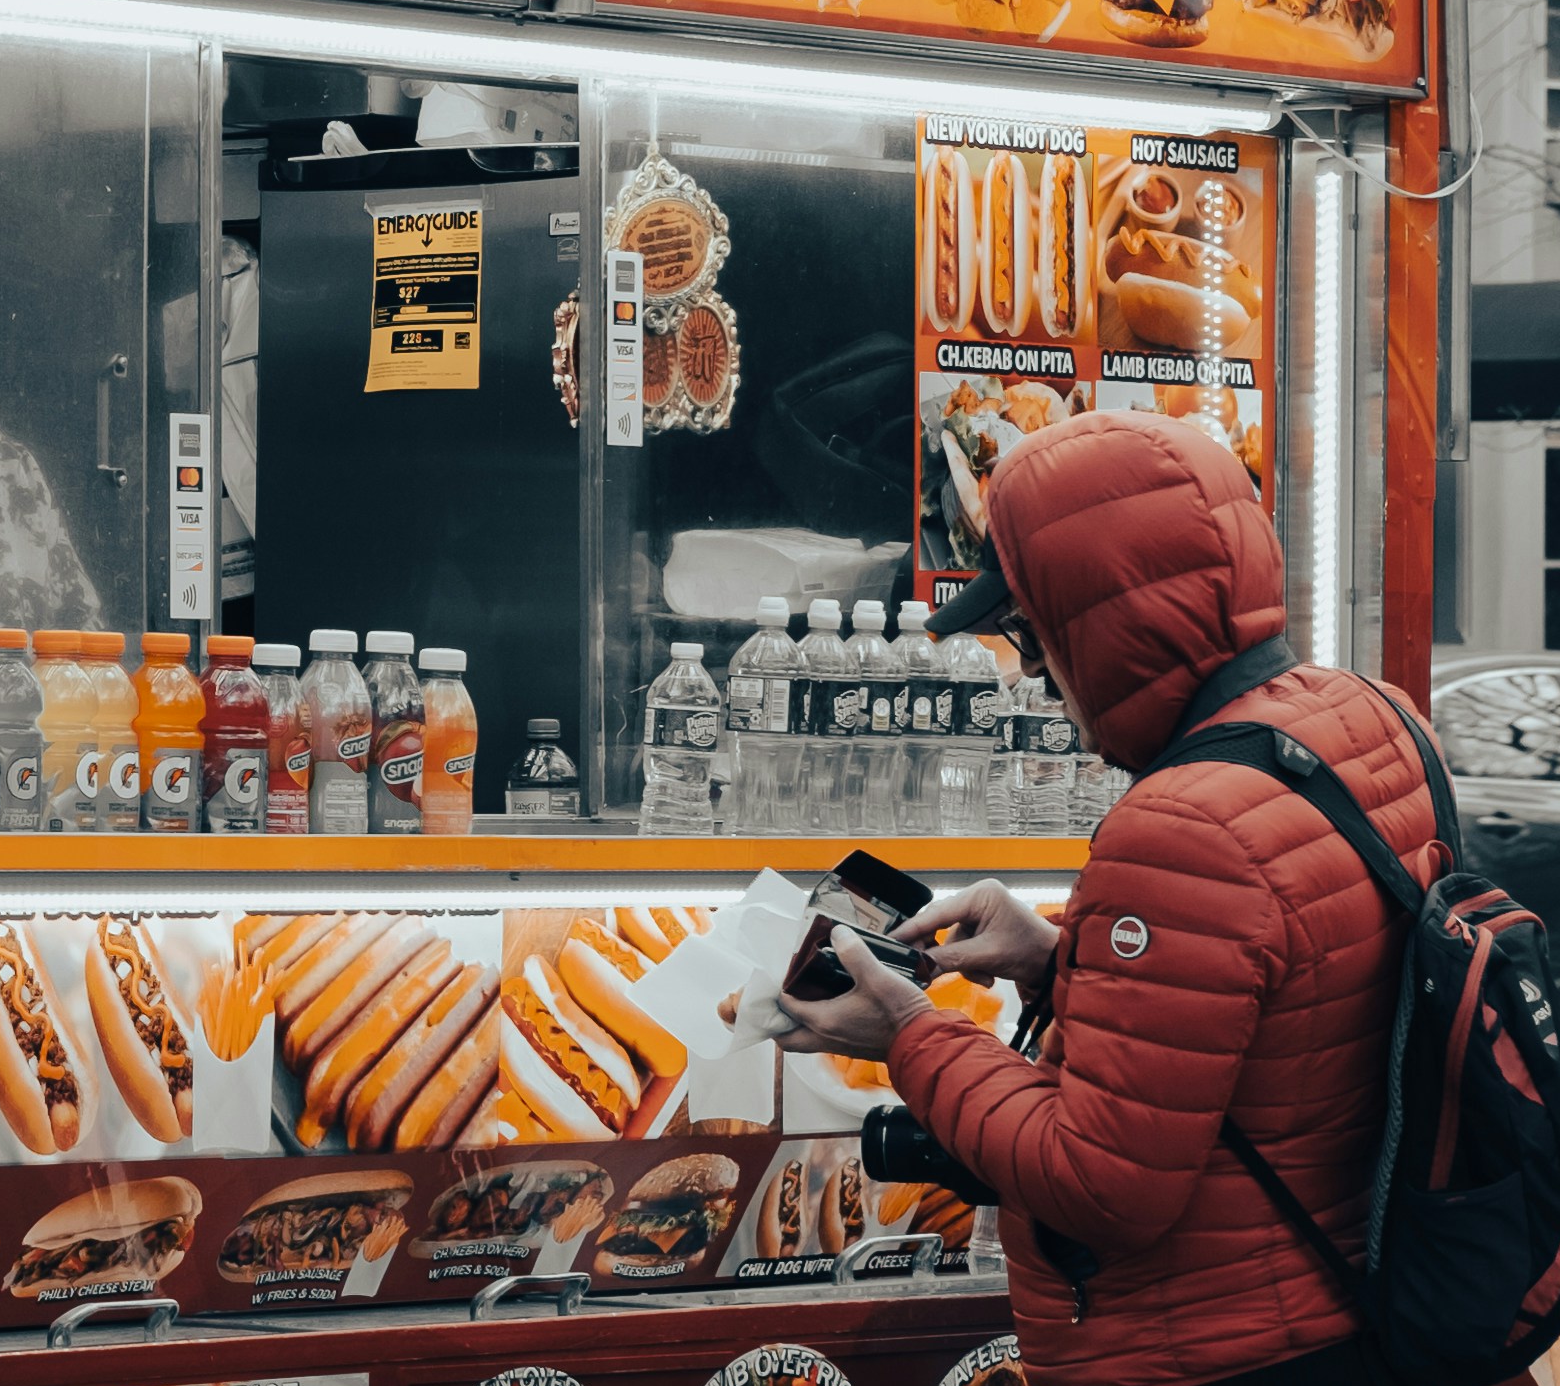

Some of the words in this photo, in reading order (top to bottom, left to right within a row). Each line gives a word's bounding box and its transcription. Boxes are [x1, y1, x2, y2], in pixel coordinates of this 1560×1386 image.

[926, 118, 964, 143] NEW
[965, 121, 1008, 147] YORK
[1012, 127, 1047, 150] HOT
[1050, 129, 1085, 153] DOG
[1132, 139, 1165, 163] HOT
[1168, 141, 1236, 168] SAUSAGE
[378, 211, 478, 237] ENERGYGUIDE
[399, 287, 420, 299] $27
[616, 346, 634, 356] VISA
[937, 344, 1013, 370] CH.KEBAB
[1015, 350, 1037, 372] ON
[1041, 351, 1073, 373] PITA
[1103, 354, 1145, 378] LAMB
[1148, 358, 1194, 380] KEBAB
[1198, 361, 1220, 382] ON
[1221, 362, 1252, 385] PITA
[180, 513, 199, 524] VISA
[6, 756, 37, 800] G
[109, 751, 139, 799] G
[152, 756, 190, 803] G
[225, 756, 260, 803] G
[485, 1265, 510, 1278] SODA
[612, 1262, 686, 1278] CHEESEBURGER
[868, 1253, 911, 1270] CHEESE
[756, 1350, 814, 1376] OVER
